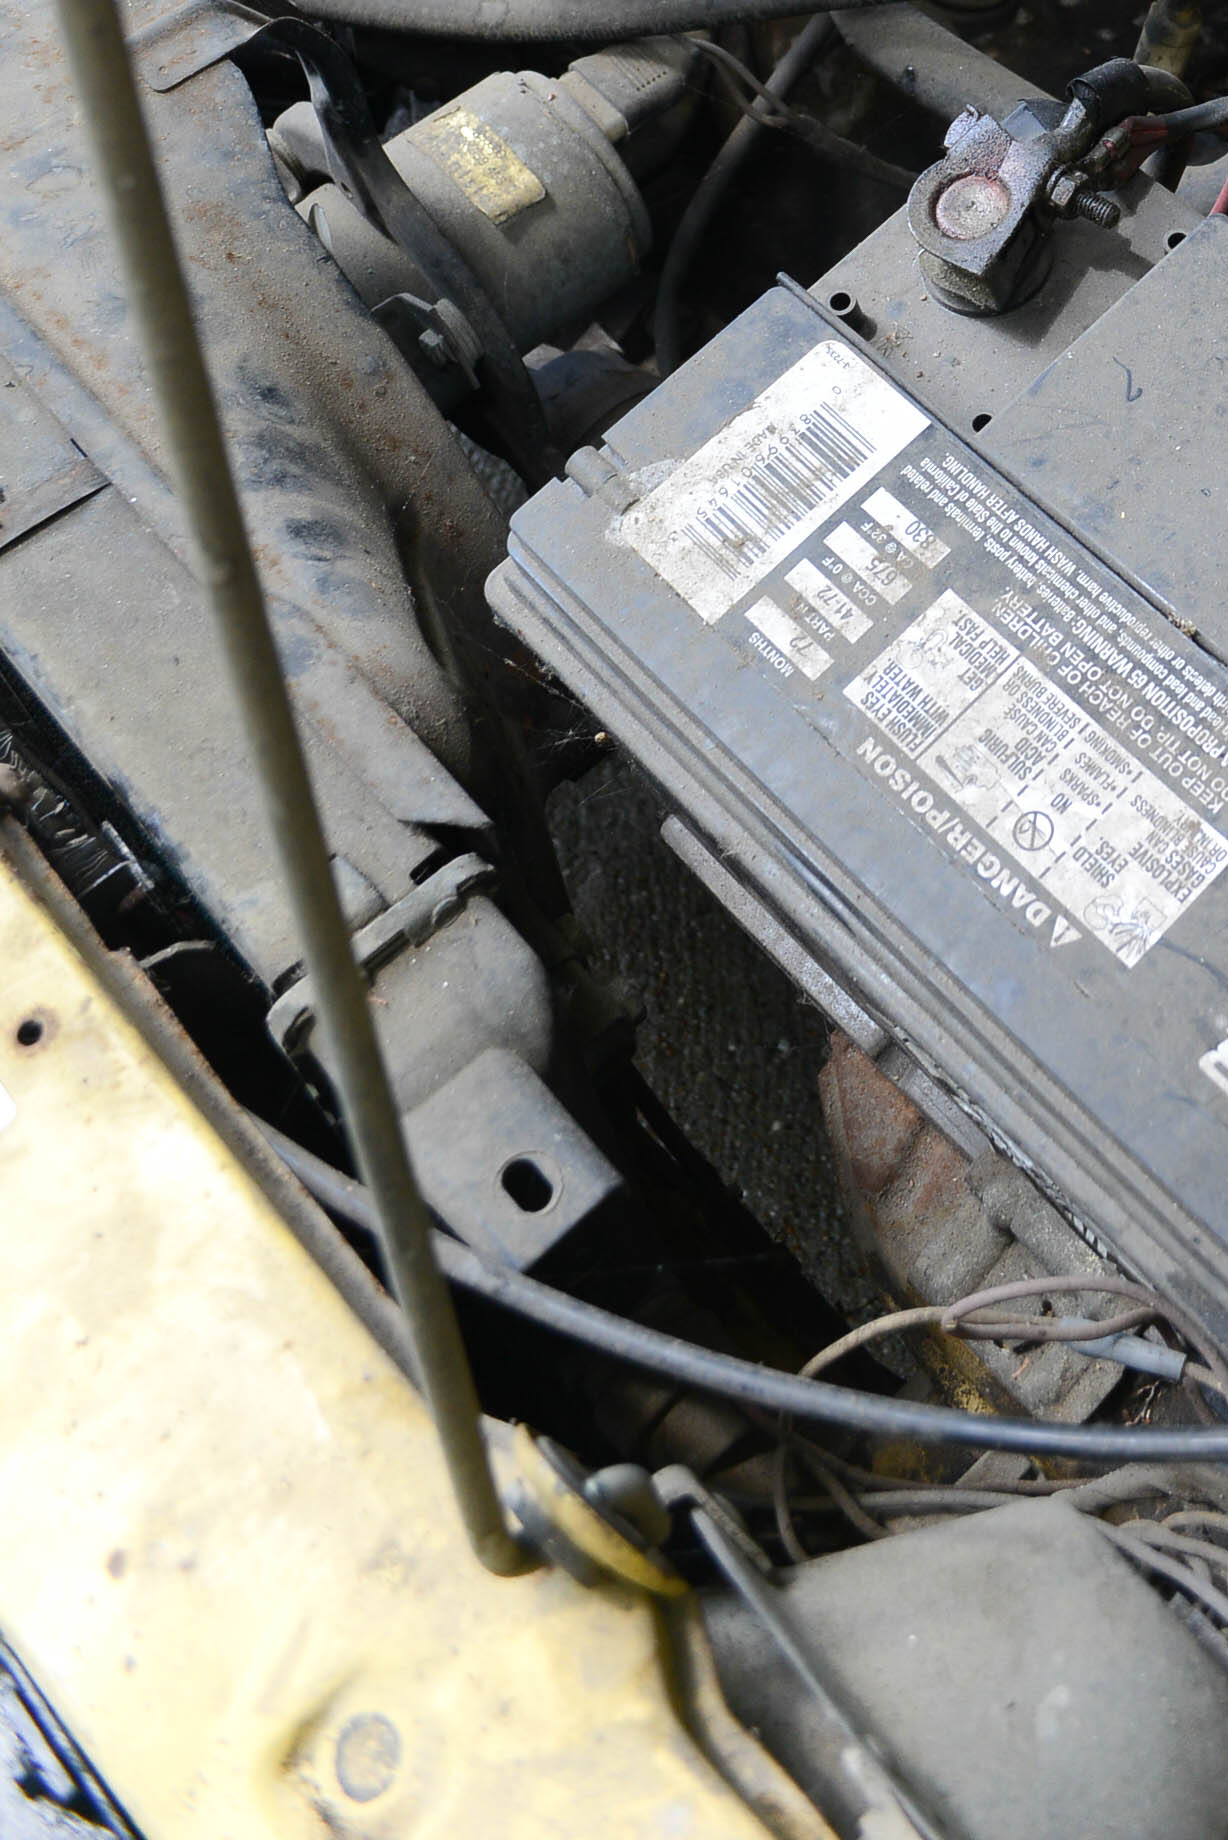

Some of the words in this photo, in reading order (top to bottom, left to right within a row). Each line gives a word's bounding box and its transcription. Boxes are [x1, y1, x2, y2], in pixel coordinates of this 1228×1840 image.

[829, 383, 843, 396] 0
[729, 449, 748, 465] IN
[899, 463, 933, 496] related
[917, 456, 961, 498] California
[938, 451, 990, 500] HANDLING.
[926, 487, 949, 510] and
[953, 489, 969, 505] of
[963, 497, 990, 523] State
[984, 491, 1019, 525] AFTER
[903, 517, 937, 550] 830
[941, 501, 985, 543] terminals
[983, 516, 1003, 535] the
[997, 527, 1012, 543] to
[1012, 516, 1050, 552] HANDS
[978, 532, 1011, 563] posts,
[1005, 535, 1039, 567] known
[1043, 544, 1077, 576] WASH
[864, 553, 899, 588] 675
[1002, 554, 1038, 589] battery
[1031, 558, 1079, 603] chemicals
[1072, 568, 1103, 598] harm.
[814, 583, 856, 623] 41-72
[850, 579, 878, 607] CCA
[1031, 580, 1076, 623] Batteries,
[1072, 594, 1101, 622] other
[802, 609, 836, 641] PART
[950, 608, 984, 642] FAST.
[987, 596, 1062, 667] CHILDREN.
[998, 584, 1064, 646] BATTERY.
[1094, 613, 1118, 636] and
[1096, 588, 1154, 643] reproductive
[746, 630, 796, 677] MONTHS
[787, 630, 816, 658] 72
[946, 630, 997, 678] MEDICAL
[977, 634, 1010, 666] HELP
[1059, 640, 1104, 682] OPEN
[1066, 613, 1135, 678] WARNING:
[1111, 625, 1171, 682] compounds,
[1147, 635, 1176, 663] other
[878, 656, 925, 701] WATER.
[956, 664, 985, 692] GET
[1056, 659, 1083, 686] OF
[1125, 666, 1150, 690] 65
[1171, 654, 1186, 669] or
[1001, 677, 1021, 697] OR
[1009, 661, 1048, 699] BURNS.
[1099, 676, 1134, 709] NOT
[1162, 672, 1188, 698] lead
[1179, 663, 1217, 699] defects
[858, 689, 892, 722] EYES
[862, 667, 939, 739] IMMEDIATELY
[916, 693, 951, 727] WITH
[1015, 689, 1070, 742] BLINDNESS
[1041, 691, 1082, 730] SEVERE
[1077, 678, 1132, 730] REACH
[1128, 703, 1157, 730] DO
[1182, 690, 1206, 713] and
[1199, 705, 1225, 731] lead
[884, 713, 924, 753] FLUSH
[1003, 702, 1039, 737] CAUSE
[1126, 722, 1154, 749] OF
[1140, 679, 1227, 760] PROPOSITION
[976, 726, 1034, 781] SULFURIC
[1012, 734, 1047, 768] ACID
[1032, 728, 1058, 754] CAN
[1152, 724, 1182, 753] TIP.
[1148, 742, 1185, 778] OUT
[1177, 747, 1213, 781] NOT
[1049, 790, 1073, 814] NO
[1180, 771, 1224, 814] KEEP
[854, 735, 1052, 928] DANGER/POISON
[1128, 792, 1186, 846] BLINDNESS
[1089, 835, 1130, 874] EYES.
[1144, 828, 1170, 854] CAN
[1180, 839, 1217, 875] CAUSE
[1207, 842, 1228, 863] OR
[1070, 844, 1116, 888] SHIELD
[1127, 840, 1193, 903] EXPLOSIVE
[1163, 847, 1206, 889] GASES
